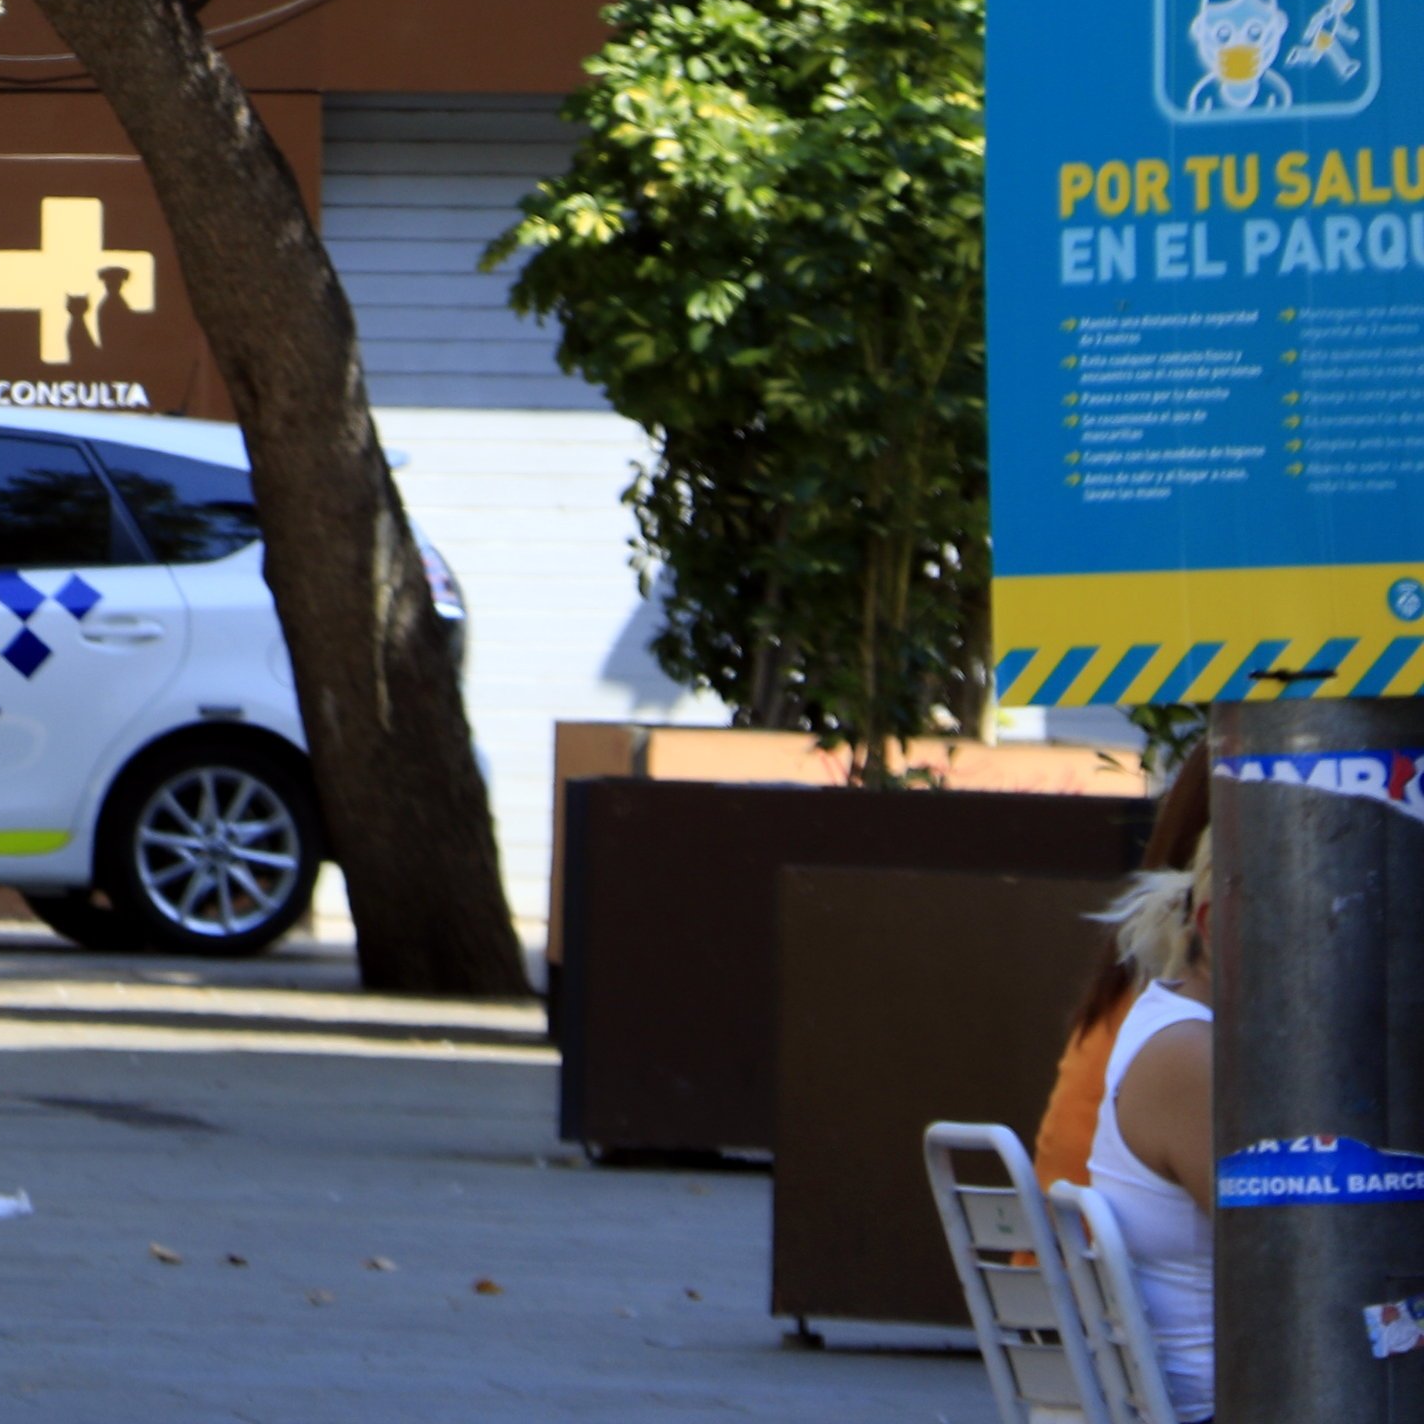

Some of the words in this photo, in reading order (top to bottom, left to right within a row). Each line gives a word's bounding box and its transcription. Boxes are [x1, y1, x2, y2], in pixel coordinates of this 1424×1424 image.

[1059, 159, 1171, 218] POR
[1184, 153, 1260, 212] TU
[1061, 223, 1137, 285] EN
[1157, 221, 1227, 279] EL
